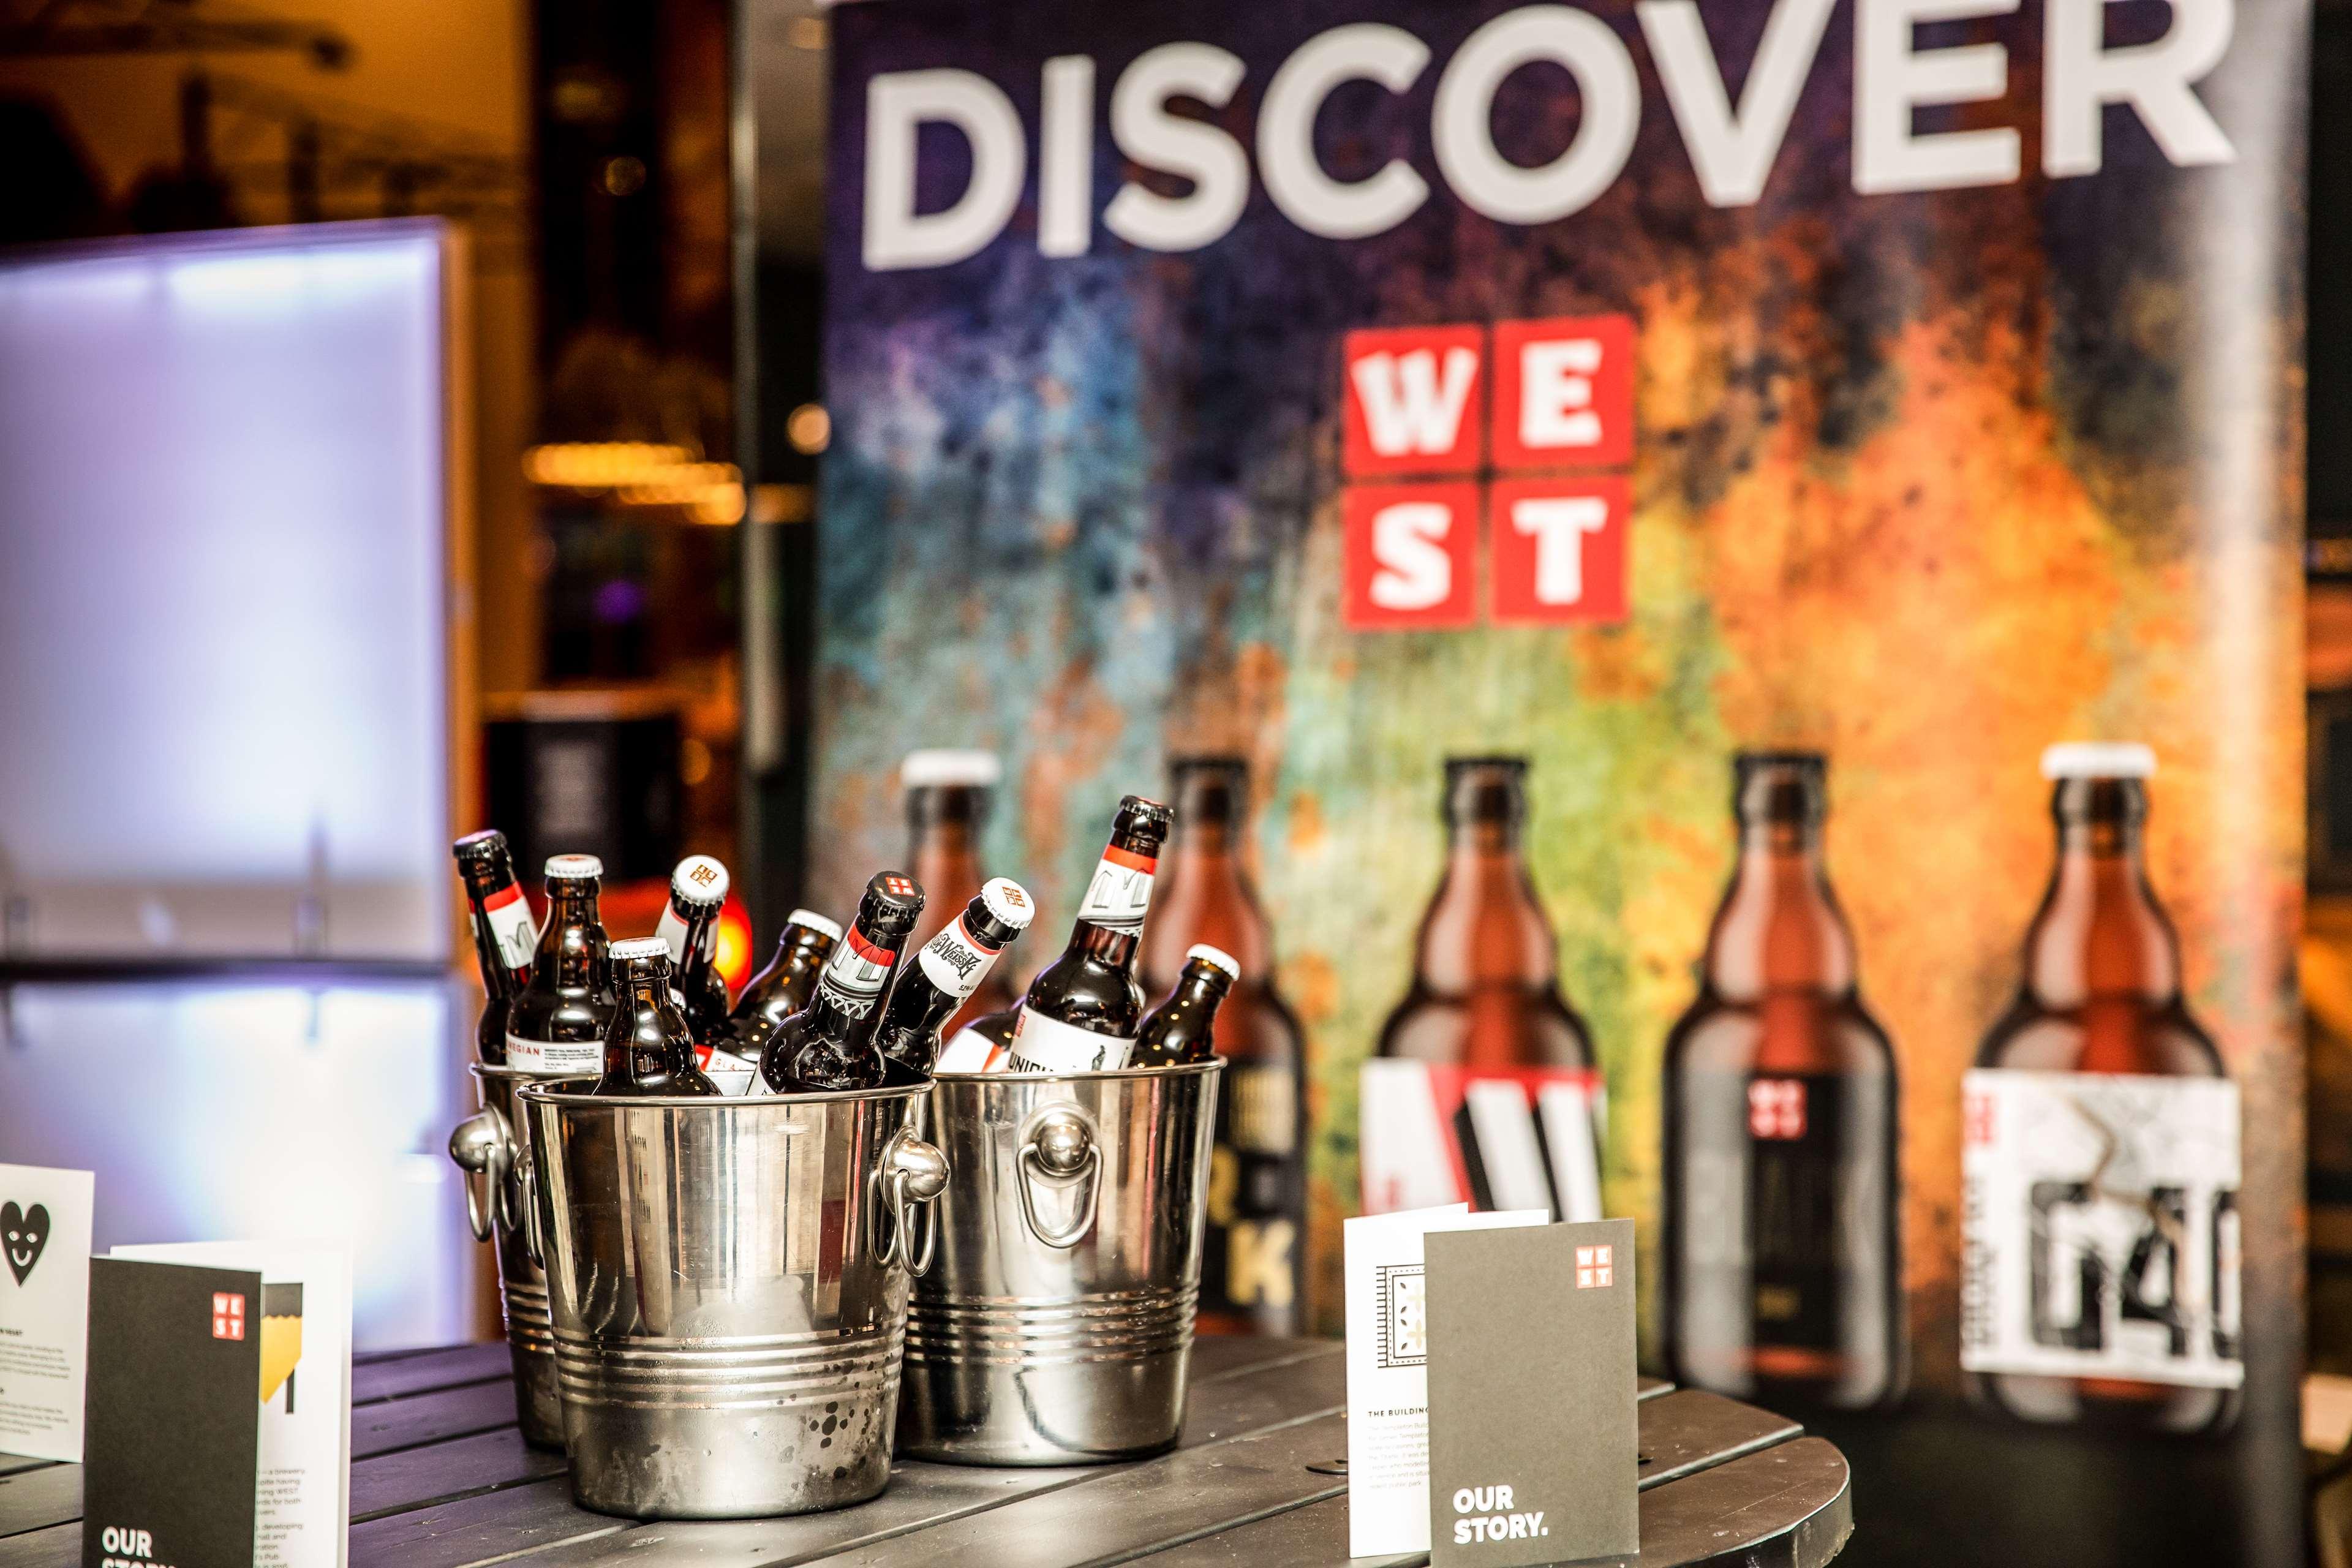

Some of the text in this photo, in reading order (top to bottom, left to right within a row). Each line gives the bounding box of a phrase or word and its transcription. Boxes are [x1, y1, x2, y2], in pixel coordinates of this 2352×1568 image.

[861, 0, 2238, 272] DISCOVER
[1453, 1485, 1514, 1513] OUR
[102, 1526, 153, 1558] OUR
[1453, 1512, 1548, 1544] STORY.
